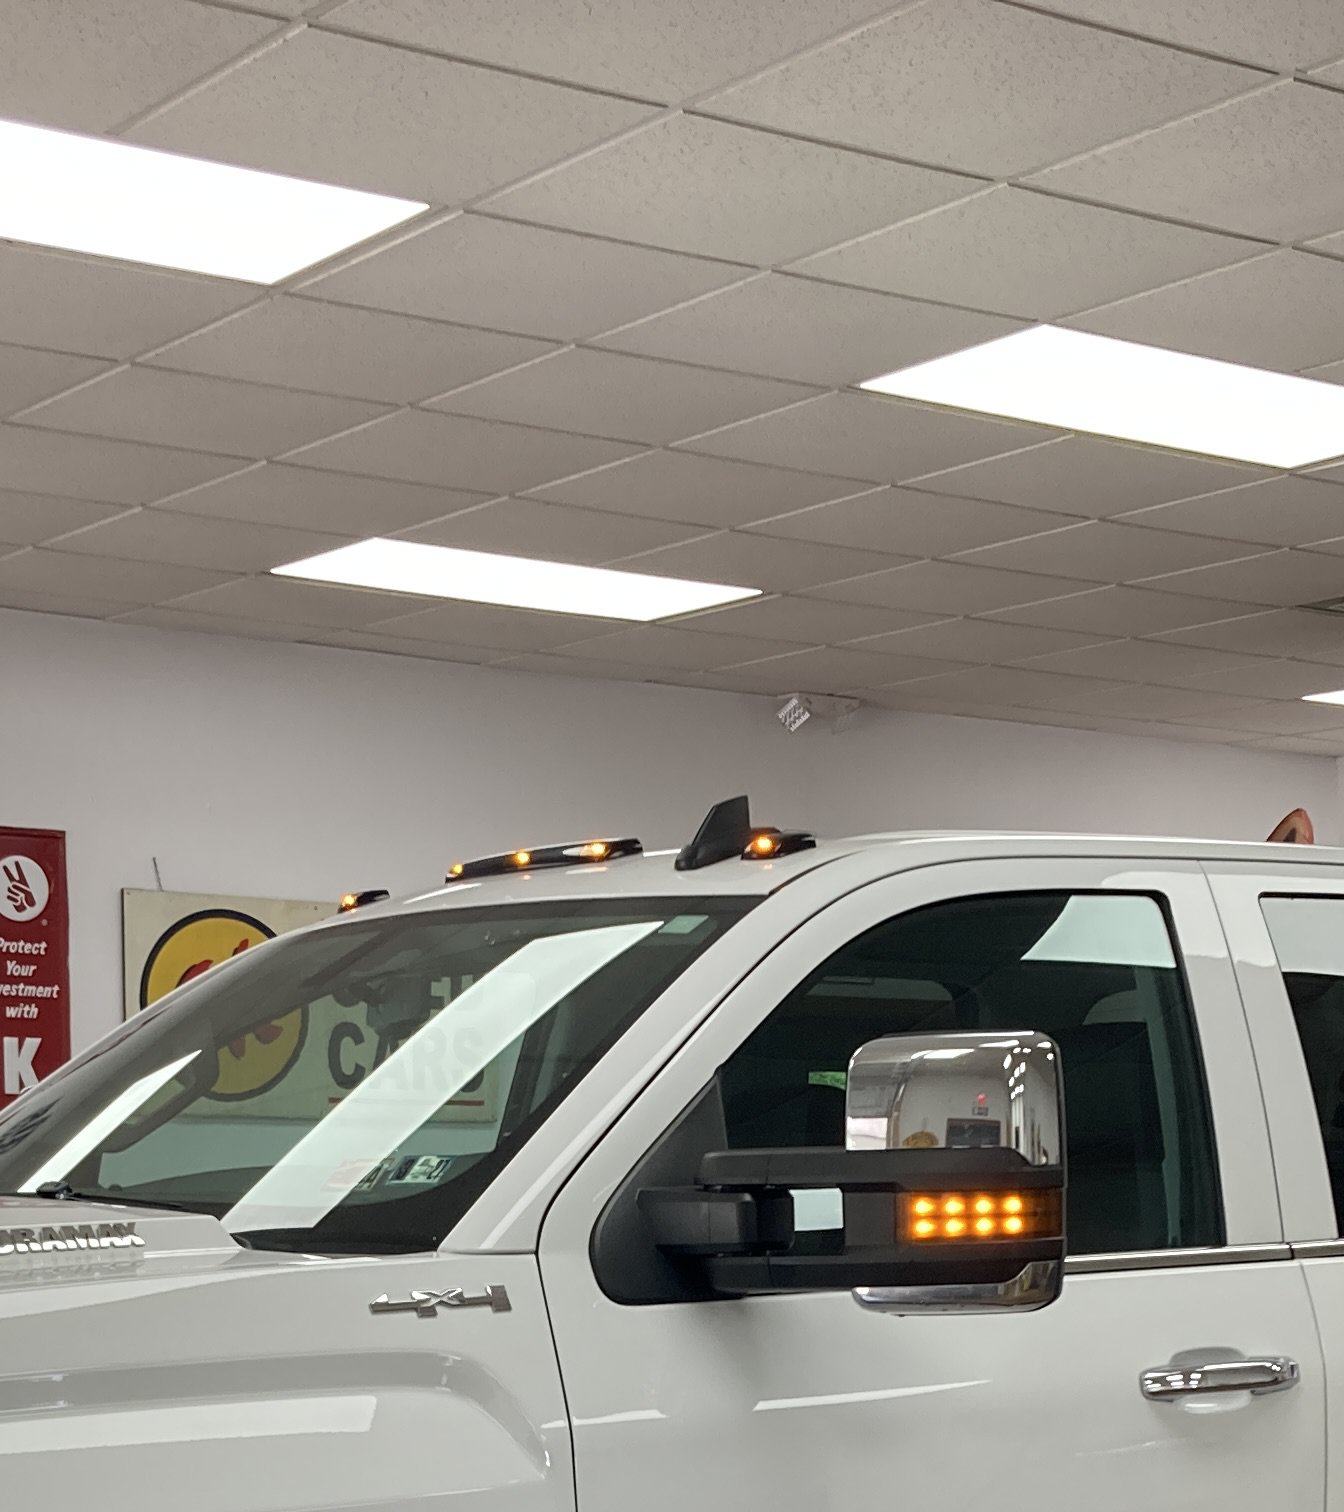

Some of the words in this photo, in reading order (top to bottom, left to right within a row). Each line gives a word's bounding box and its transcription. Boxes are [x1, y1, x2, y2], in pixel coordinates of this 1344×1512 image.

[6, 960, 37, 977] Your
[5, 1002, 39, 1019] with
[2, 1036, 42, 1095] K
[327, 1020, 485, 1093] CARS
